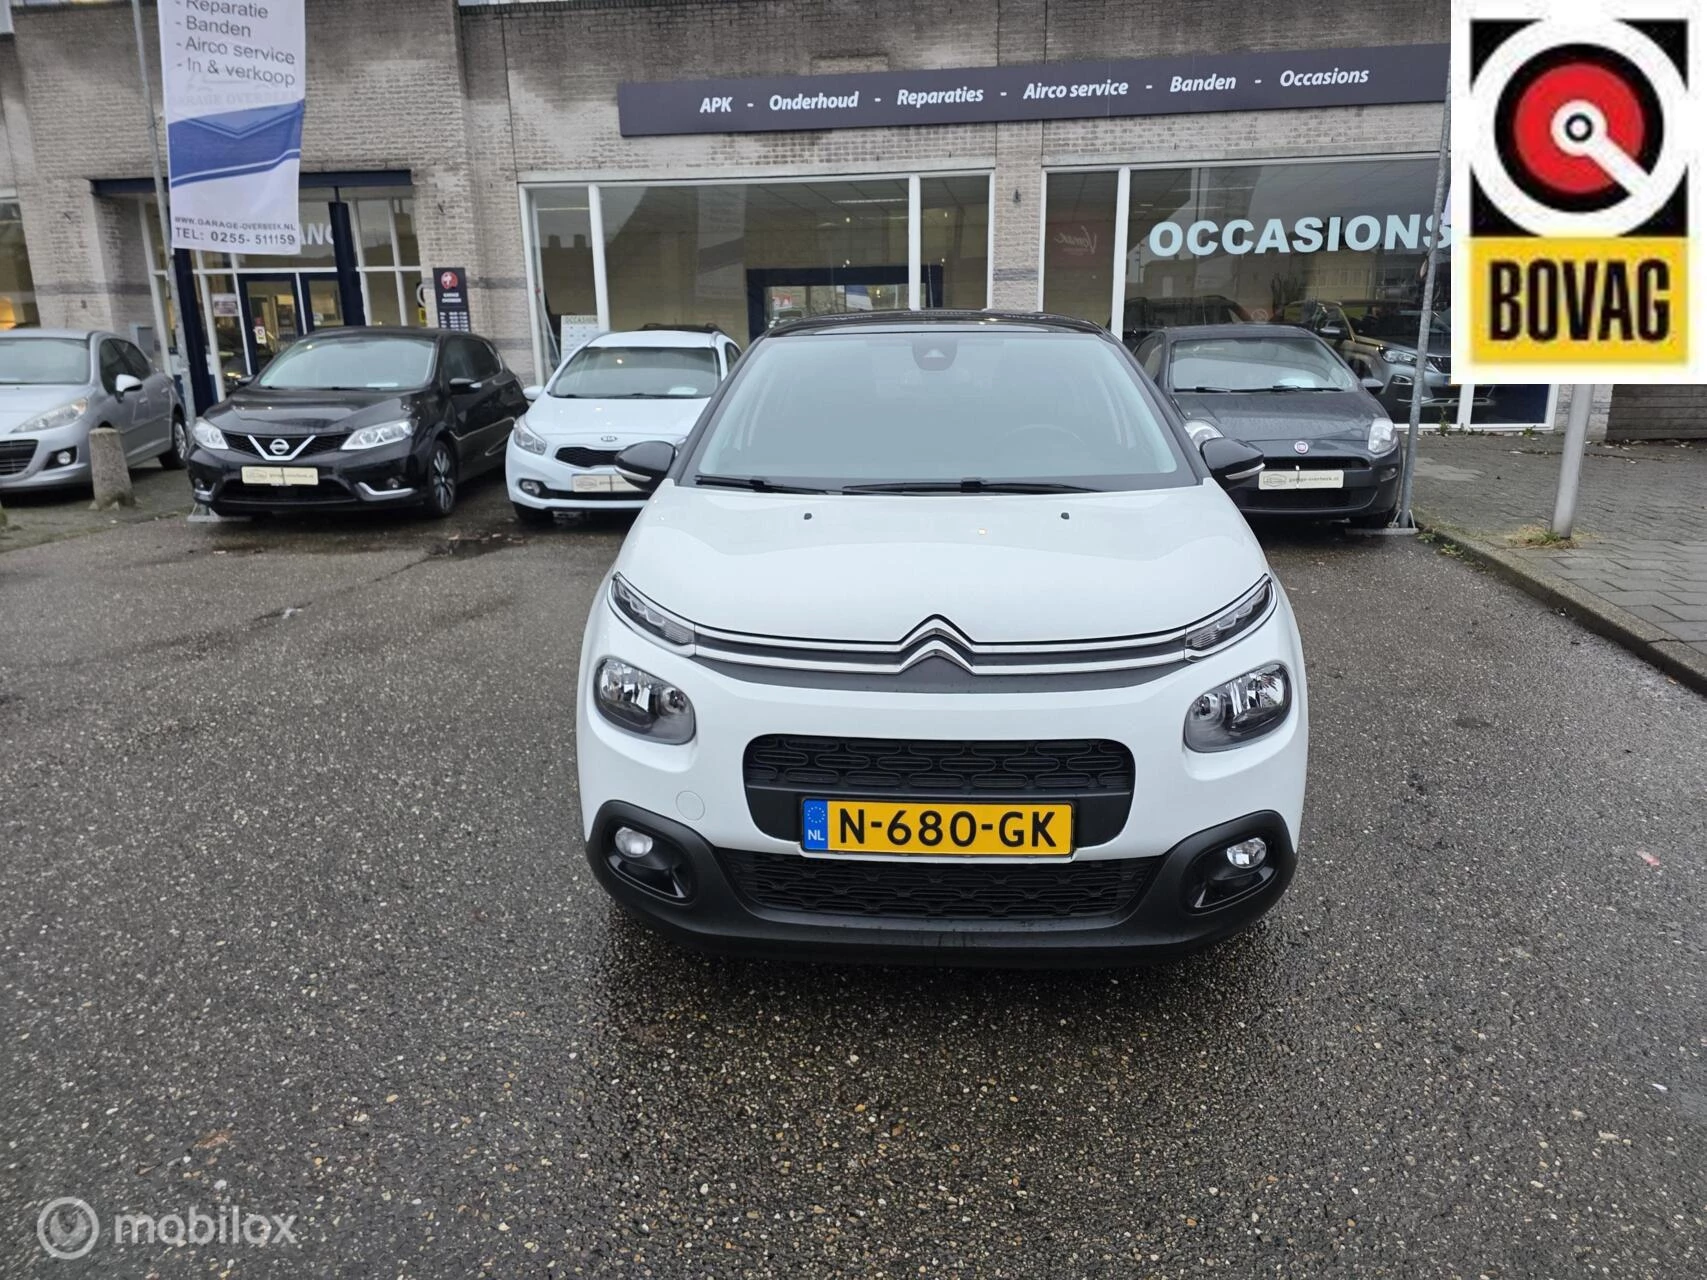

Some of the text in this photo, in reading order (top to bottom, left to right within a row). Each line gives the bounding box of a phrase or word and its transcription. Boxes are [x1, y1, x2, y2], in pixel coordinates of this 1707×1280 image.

[186, 0, 268, 19] Reparatie
[186, 15, 251, 37] Banden
[185, 36, 295, 65] Airco service
[187, 57, 295, 88] In & verkoop
[700, 67, 1369, 113] APK Onderhoud Reparaties Airco service Banden Occasions
[175, 227, 204, 241] TEL:
[211, 231, 250, 245] 0255-
[255, 234, 295, 246] 511159
[1149, 214, 1451, 257] OCCASIONS
[808, 829, 825, 842] NL
[839, 808, 1057, 848] N-680-GK
